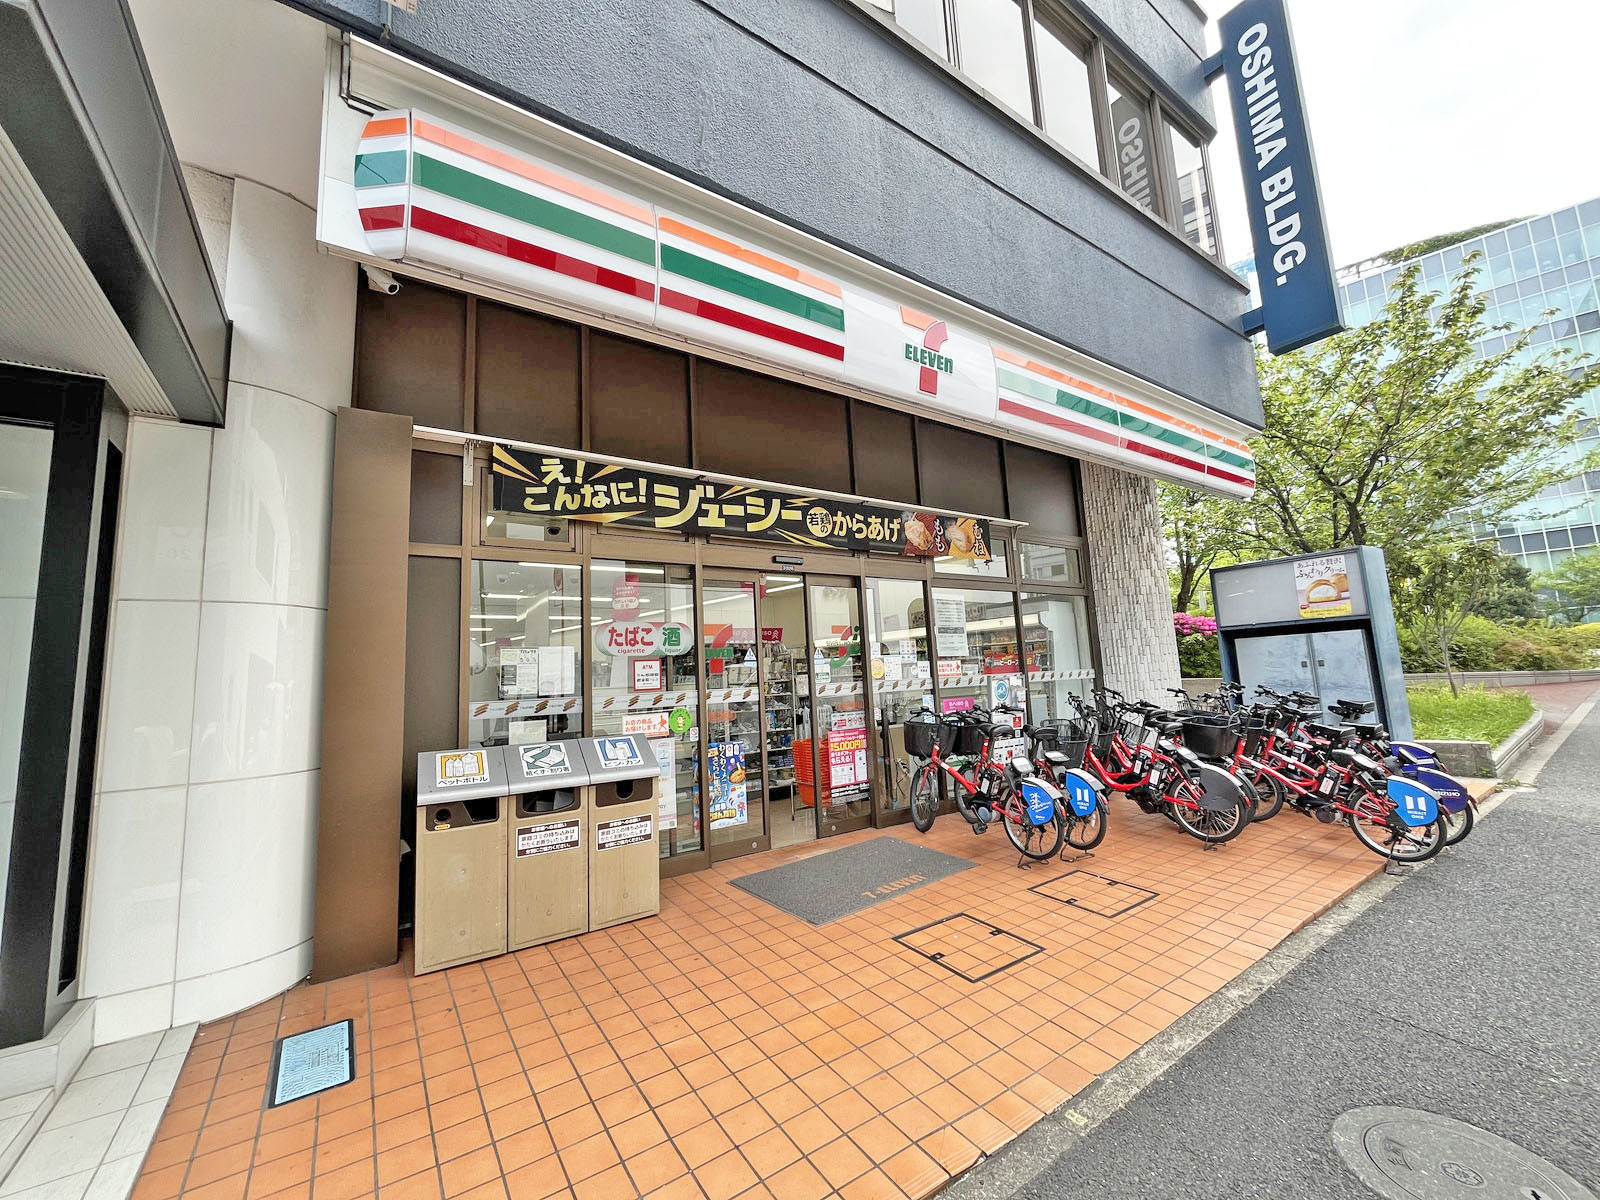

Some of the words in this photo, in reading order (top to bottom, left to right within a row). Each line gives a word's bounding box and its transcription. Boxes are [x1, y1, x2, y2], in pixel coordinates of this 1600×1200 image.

[1237, 22, 1287, 171] OSHIMA
[1260, 165, 1306, 286] BLDG.
[653, 484, 803, 532] ジューシー
[833, 510, 903, 543] からあげ
[934, 518, 946, 552] もも
[972, 522, 987, 557] むね
[608, 626, 654, 647] たばこ
[662, 626, 681, 647] 酒
[625, 718, 653, 726] お店の商品
[625, 724, 657, 732] お届けします
[603, 759, 641, 767] ビン・カン
[438, 776, 488, 785] ペットボトル
